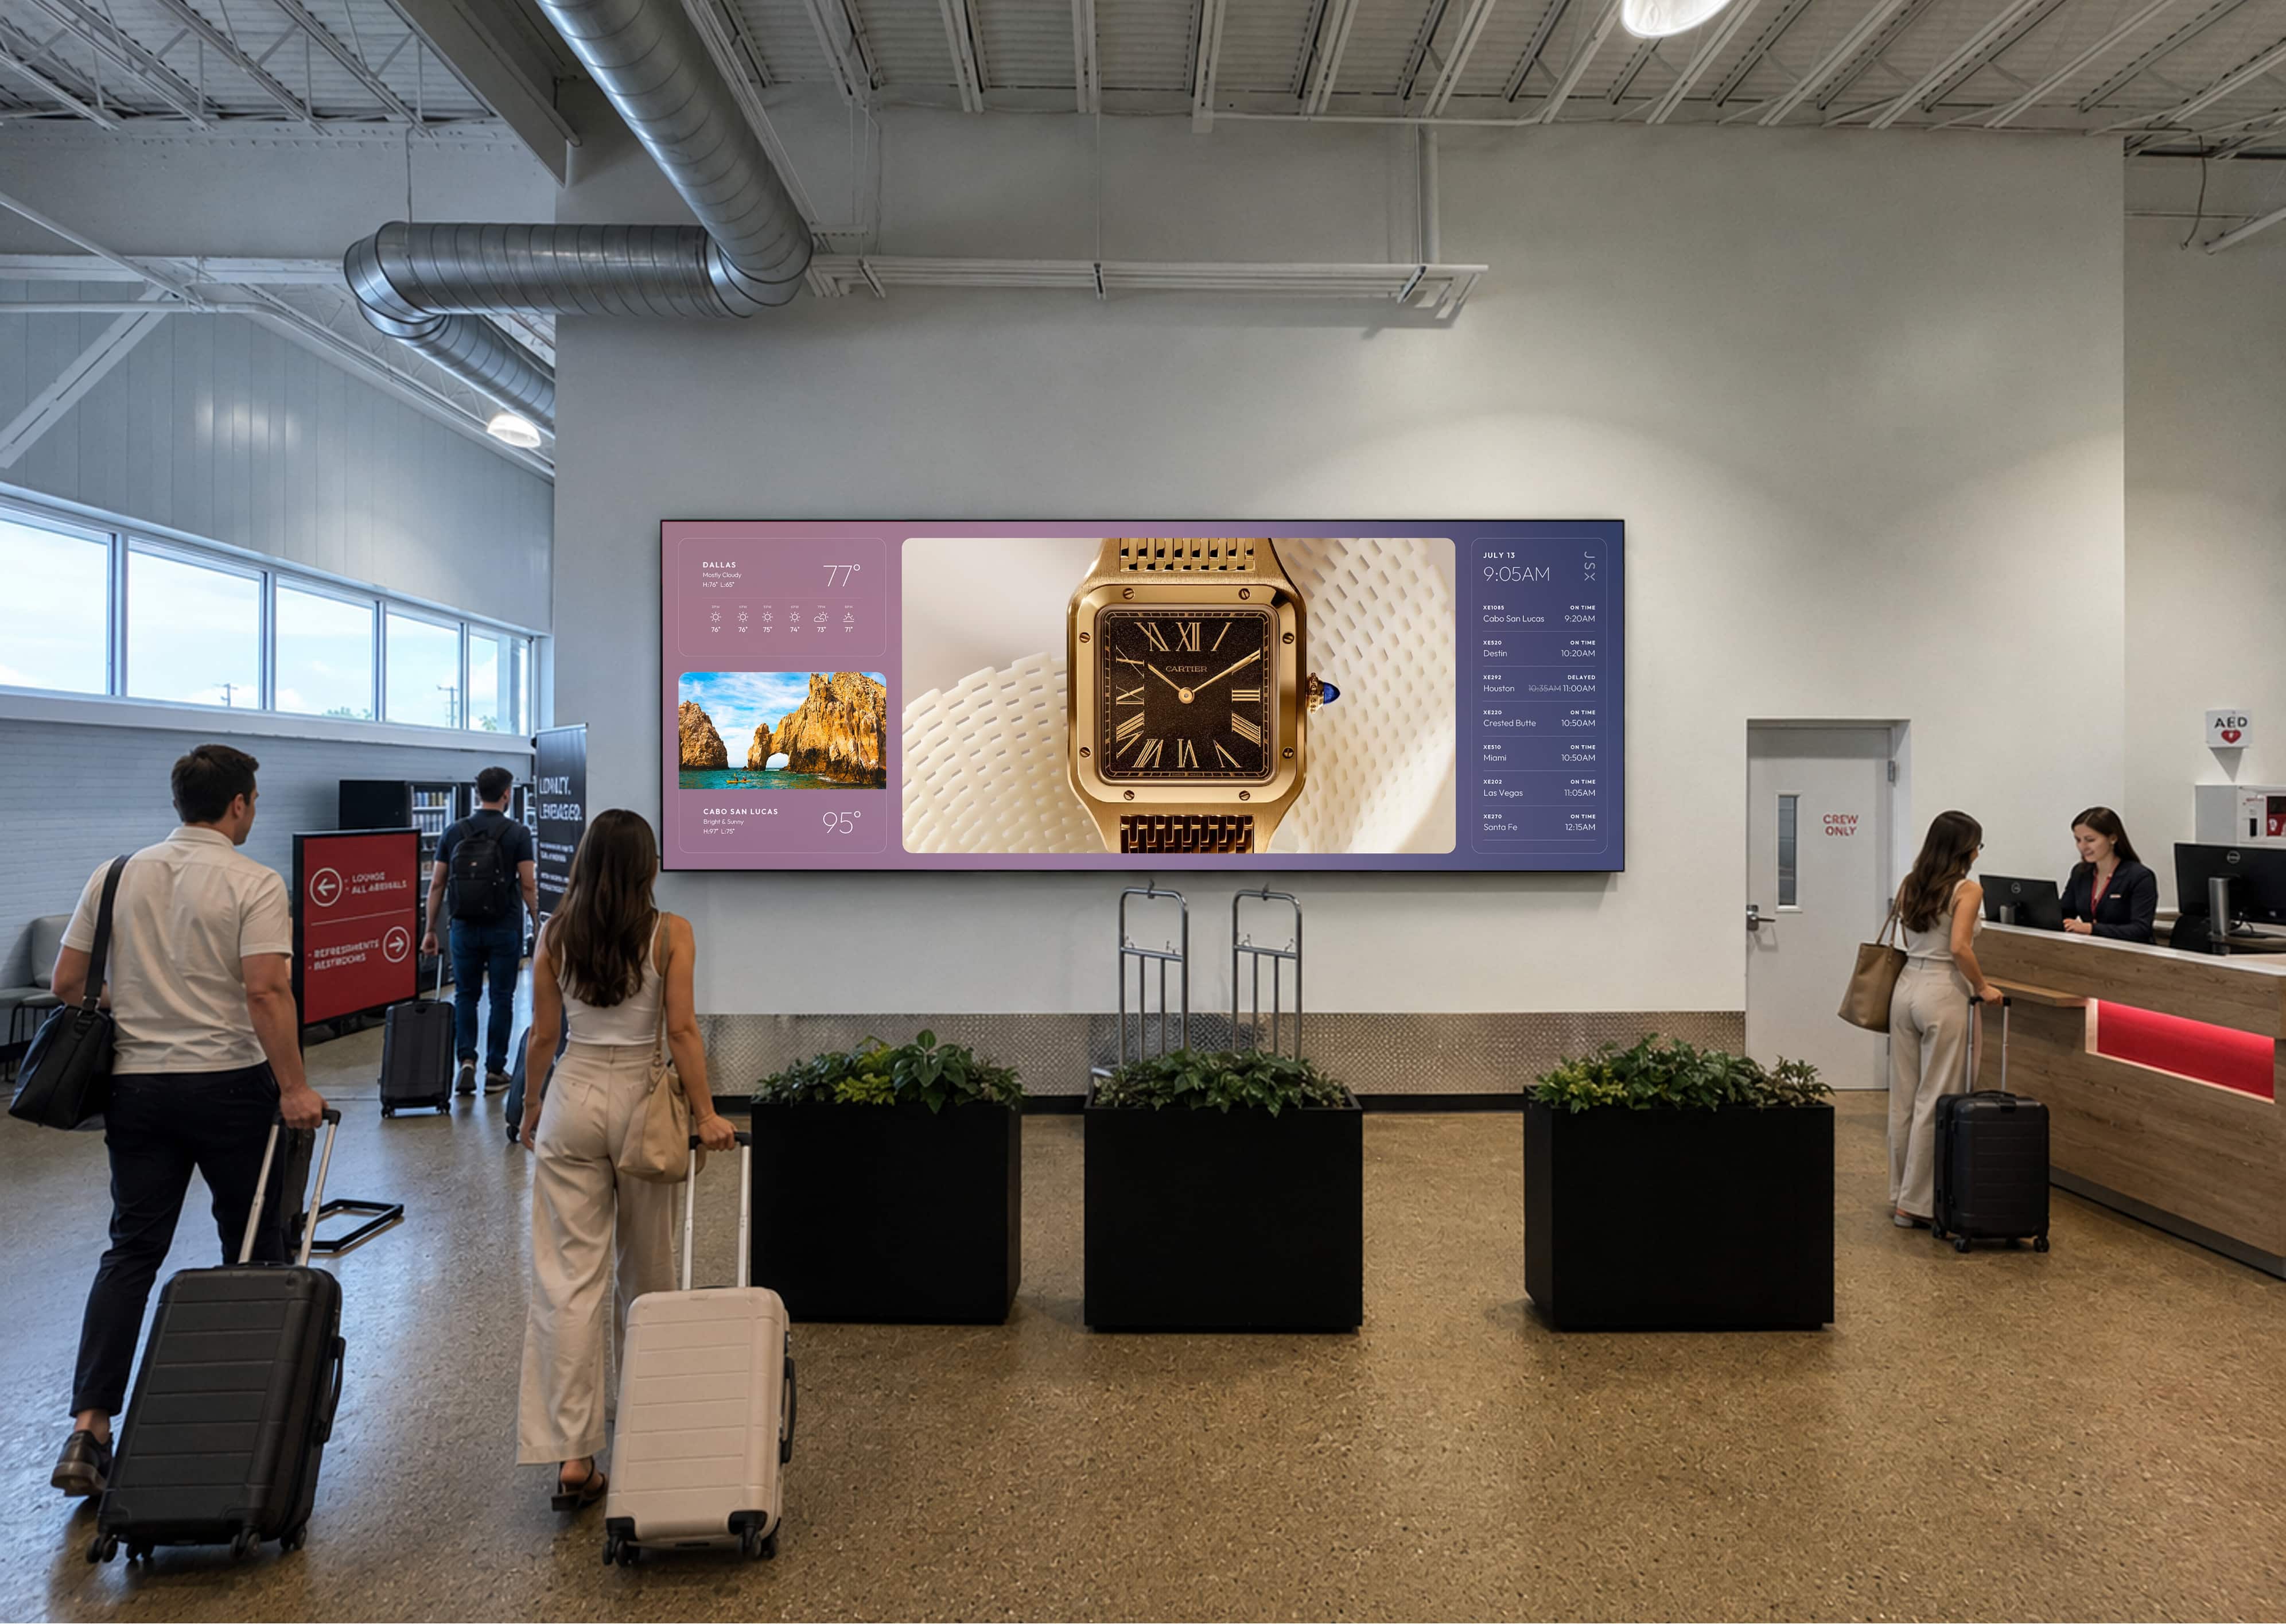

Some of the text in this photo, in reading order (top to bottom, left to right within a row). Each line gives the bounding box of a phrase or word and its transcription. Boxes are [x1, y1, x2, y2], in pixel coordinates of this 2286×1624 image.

[1484, 566, 1549, 581] 9:05AM
[1584, 551, 1595, 581] JSX
[823, 564, 860, 586] 77°
[1176, 622, 1201, 651] XII
[1231, 687, 1261, 702] III
[2214, 717, 2247, 729] AED
[1499, 790, 1523, 798] Vegas
[823, 811, 861, 834] 95°
[1823, 814, 1858, 824] CREW
[1825, 826, 1856, 836] ONLY
[352, 885, 367, 894] ALL
